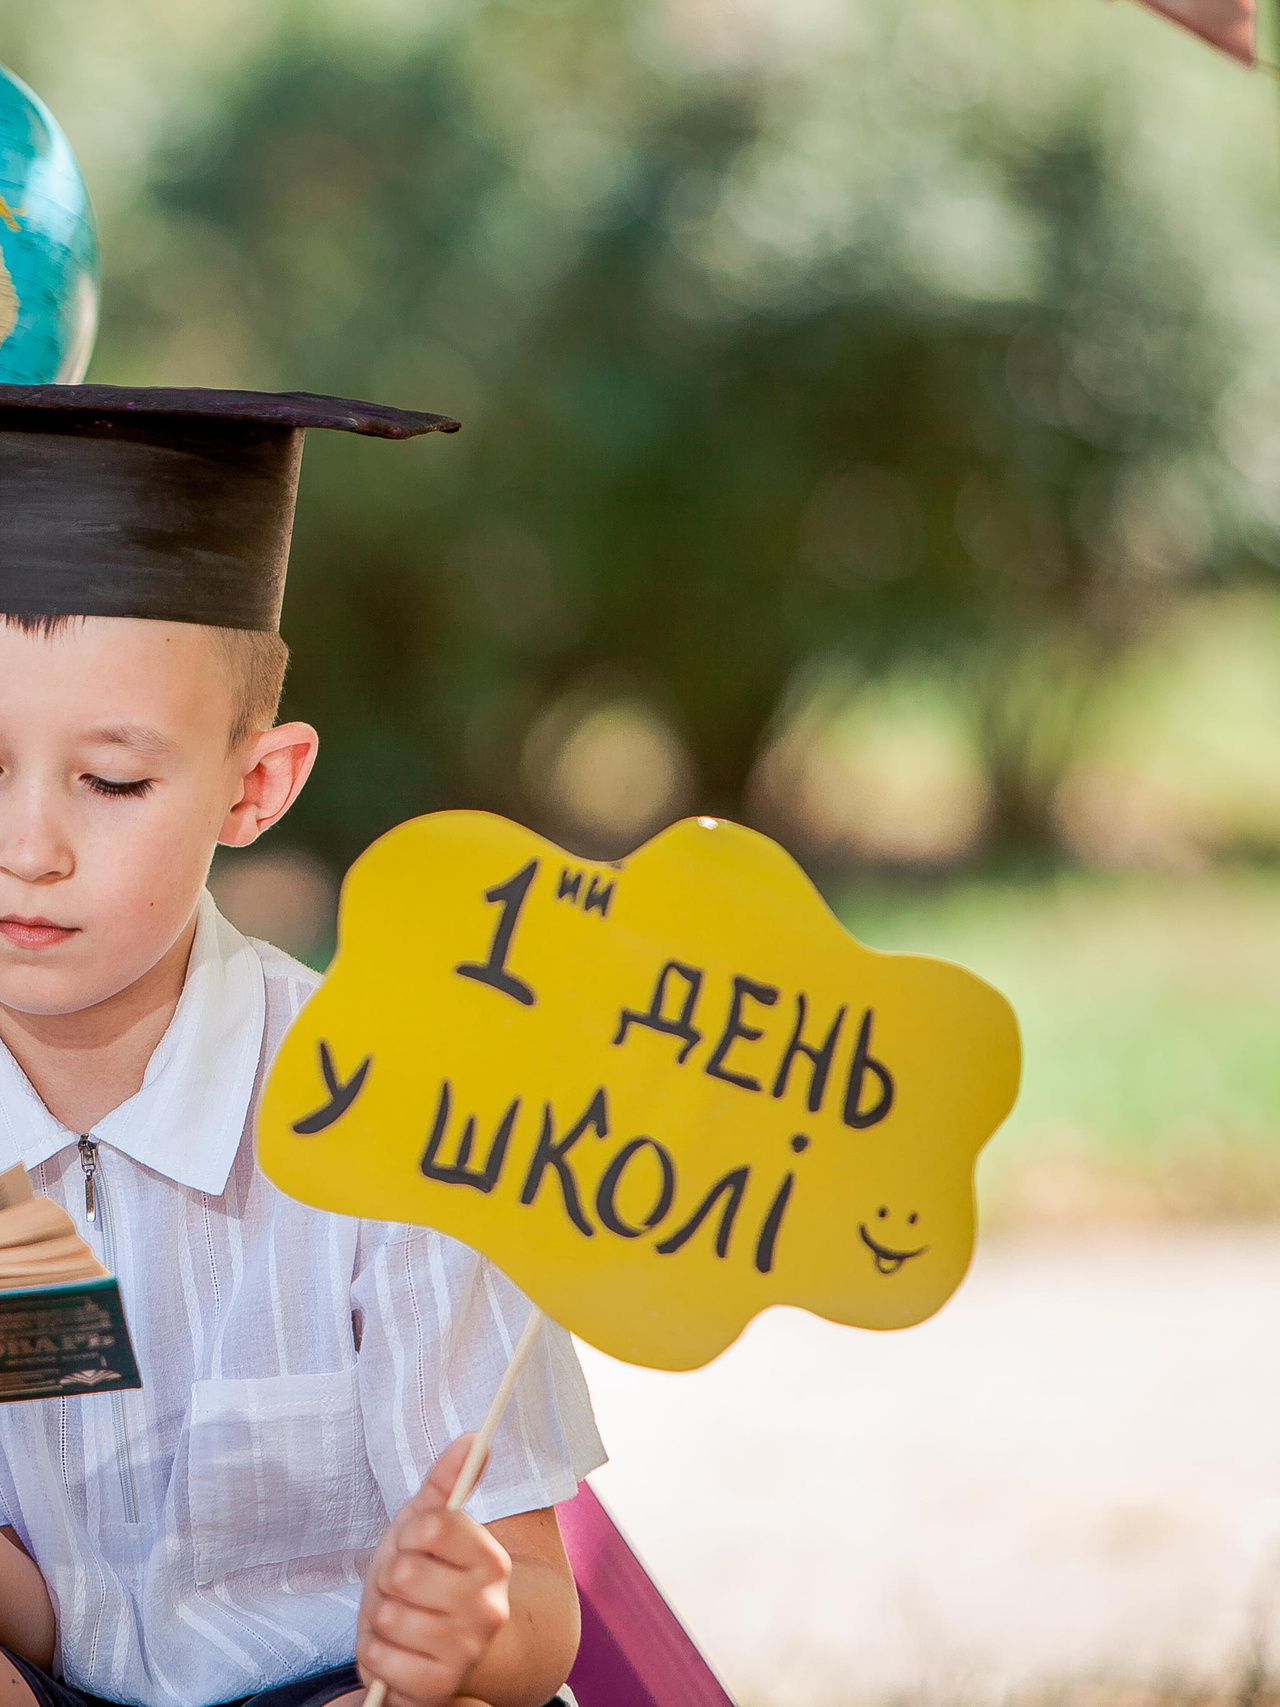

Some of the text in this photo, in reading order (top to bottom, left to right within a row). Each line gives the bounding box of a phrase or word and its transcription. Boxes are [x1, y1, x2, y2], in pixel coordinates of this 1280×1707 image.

[613, 961, 894, 1130] ДЕНЬ
[292, 1042, 809, 1274] У ШКОЛІ
